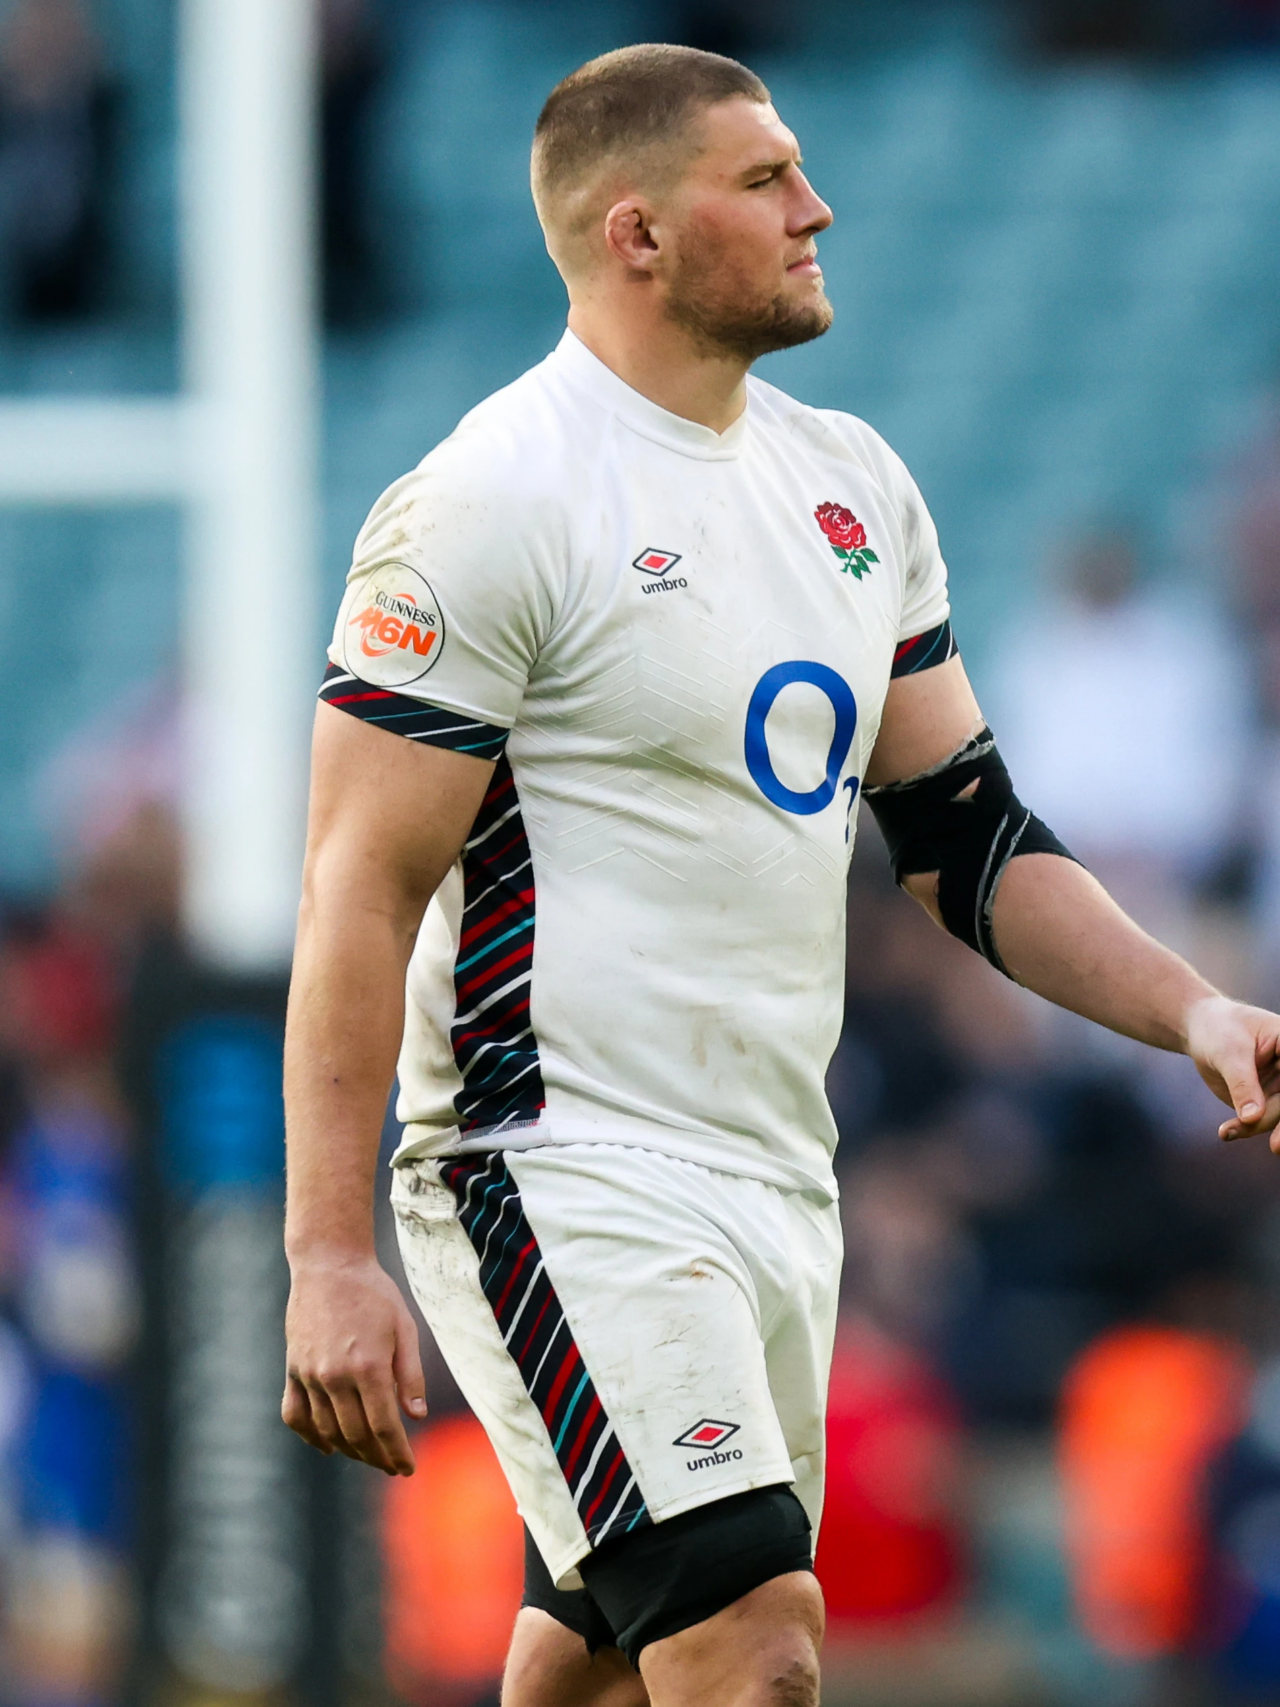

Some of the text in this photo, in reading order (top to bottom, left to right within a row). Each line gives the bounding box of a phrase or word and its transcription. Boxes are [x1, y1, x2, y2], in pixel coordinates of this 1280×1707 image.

[641, 577, 688, 595] umbro
[375, 590, 437, 627] GUINNESS
[686, 1448, 743, 1472] umbro
